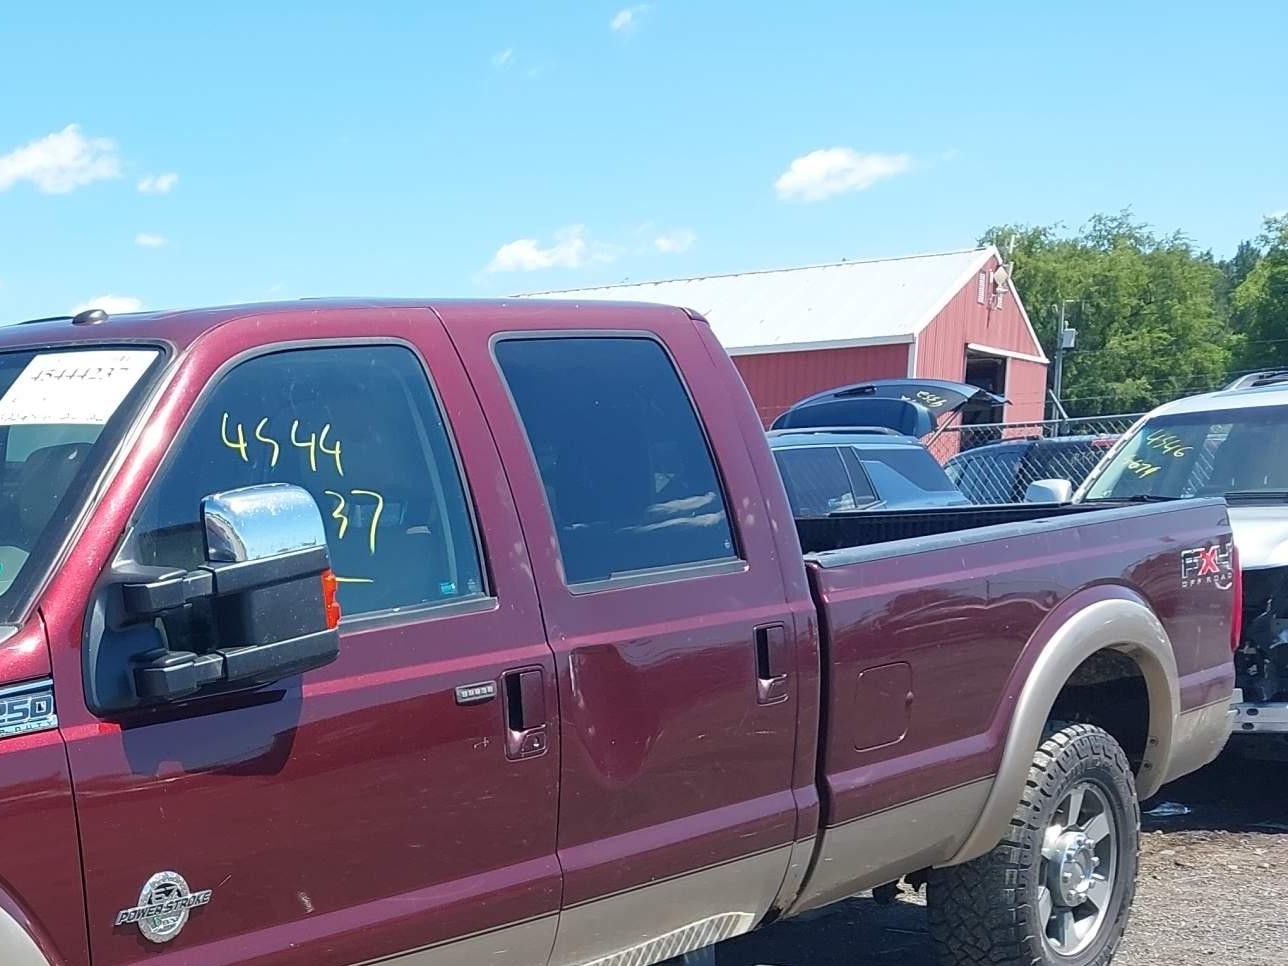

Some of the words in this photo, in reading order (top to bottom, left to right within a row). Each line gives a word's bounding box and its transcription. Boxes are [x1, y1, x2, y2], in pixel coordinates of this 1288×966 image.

[220, 412, 345, 477] 4544
[1145, 428, 1194, 458] 4546
[324, 489, 384, 556] 37
[15, 721, 54, 733] DUTY
